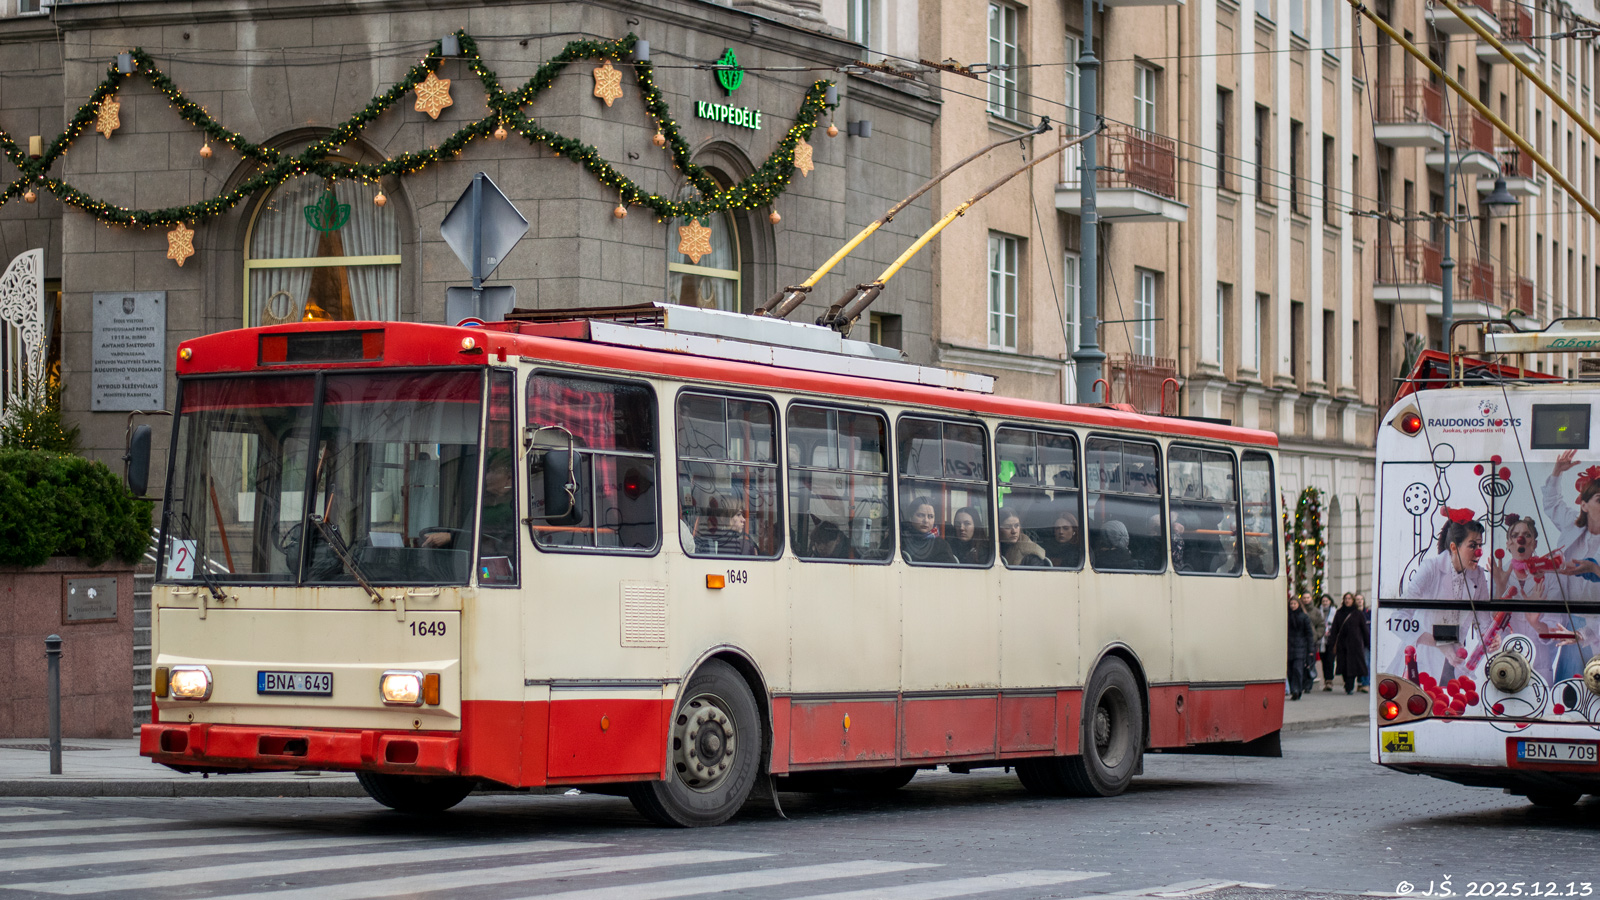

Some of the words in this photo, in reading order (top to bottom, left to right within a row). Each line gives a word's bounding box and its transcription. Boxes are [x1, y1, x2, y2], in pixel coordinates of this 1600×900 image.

[698, 100, 762, 130] KATPĖDĖLĖ
[1427, 418, 1485, 427] RAUDONOS
[175, 547, 187, 572] 2
[726, 569, 748, 584] 1649
[409, 621, 446, 636] 1649
[1385, 618, 1420, 632] 1709
[266, 674, 296, 690] BNA
[304, 675, 329, 691] 649
[1527, 743, 1558, 759] BNA
[1568, 745, 1595, 760] 709
